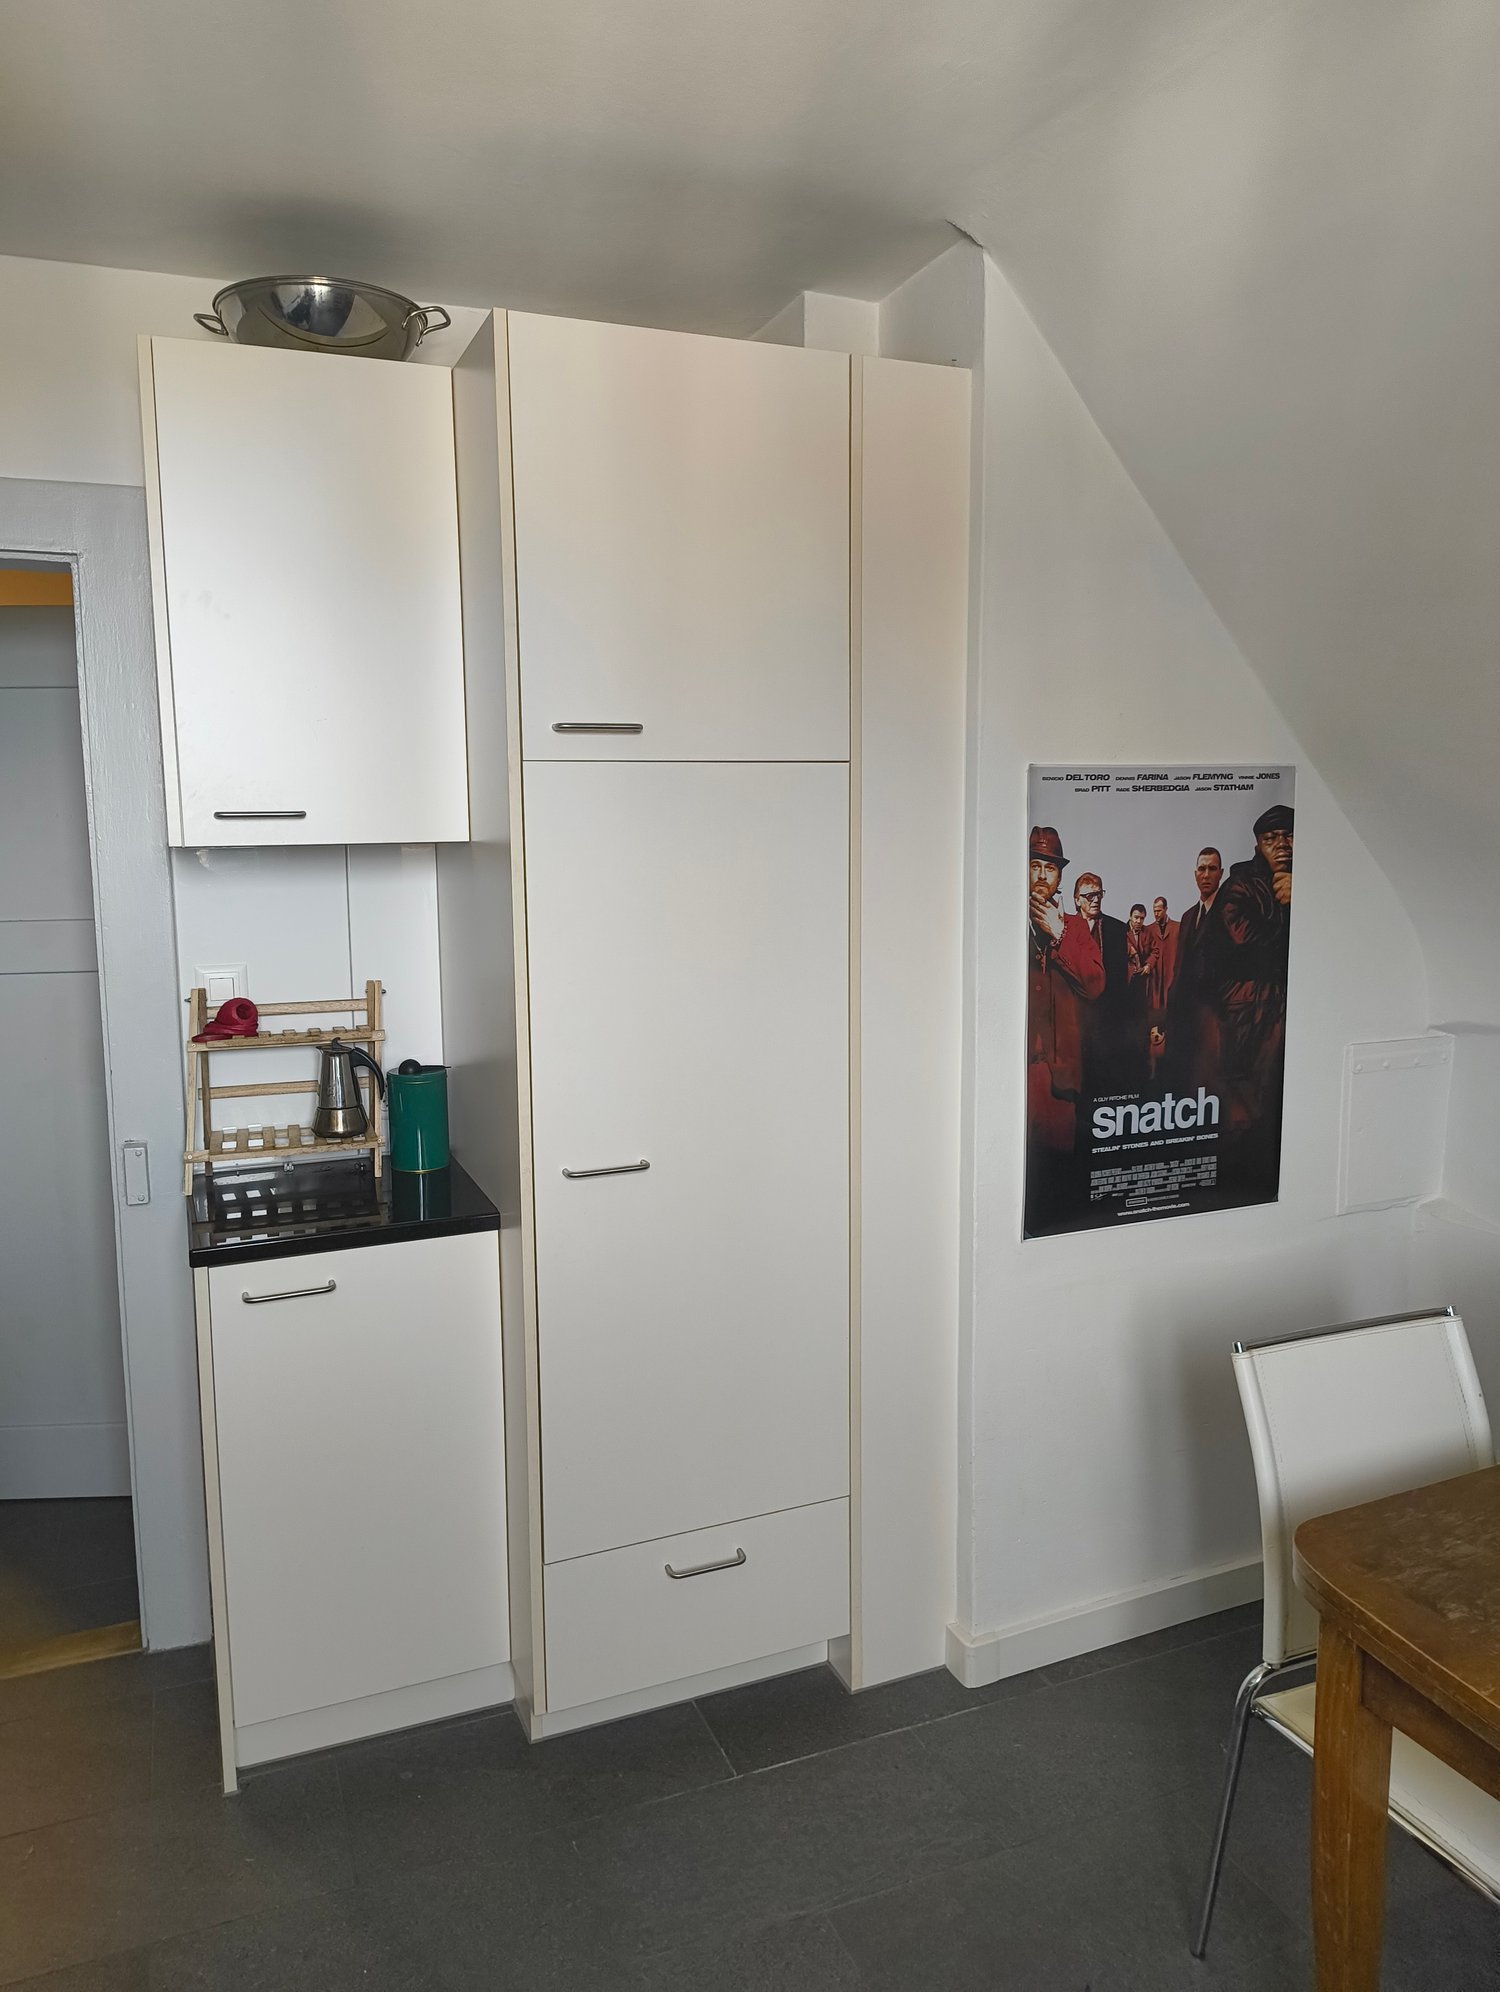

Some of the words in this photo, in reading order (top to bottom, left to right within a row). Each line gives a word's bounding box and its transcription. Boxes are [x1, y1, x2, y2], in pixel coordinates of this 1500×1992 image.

[1092, 1086, 1220, 1138] snatch
[1092, 1146, 1121, 1154] STEALIN'
[1122, 1142, 1148, 1150] STONES
